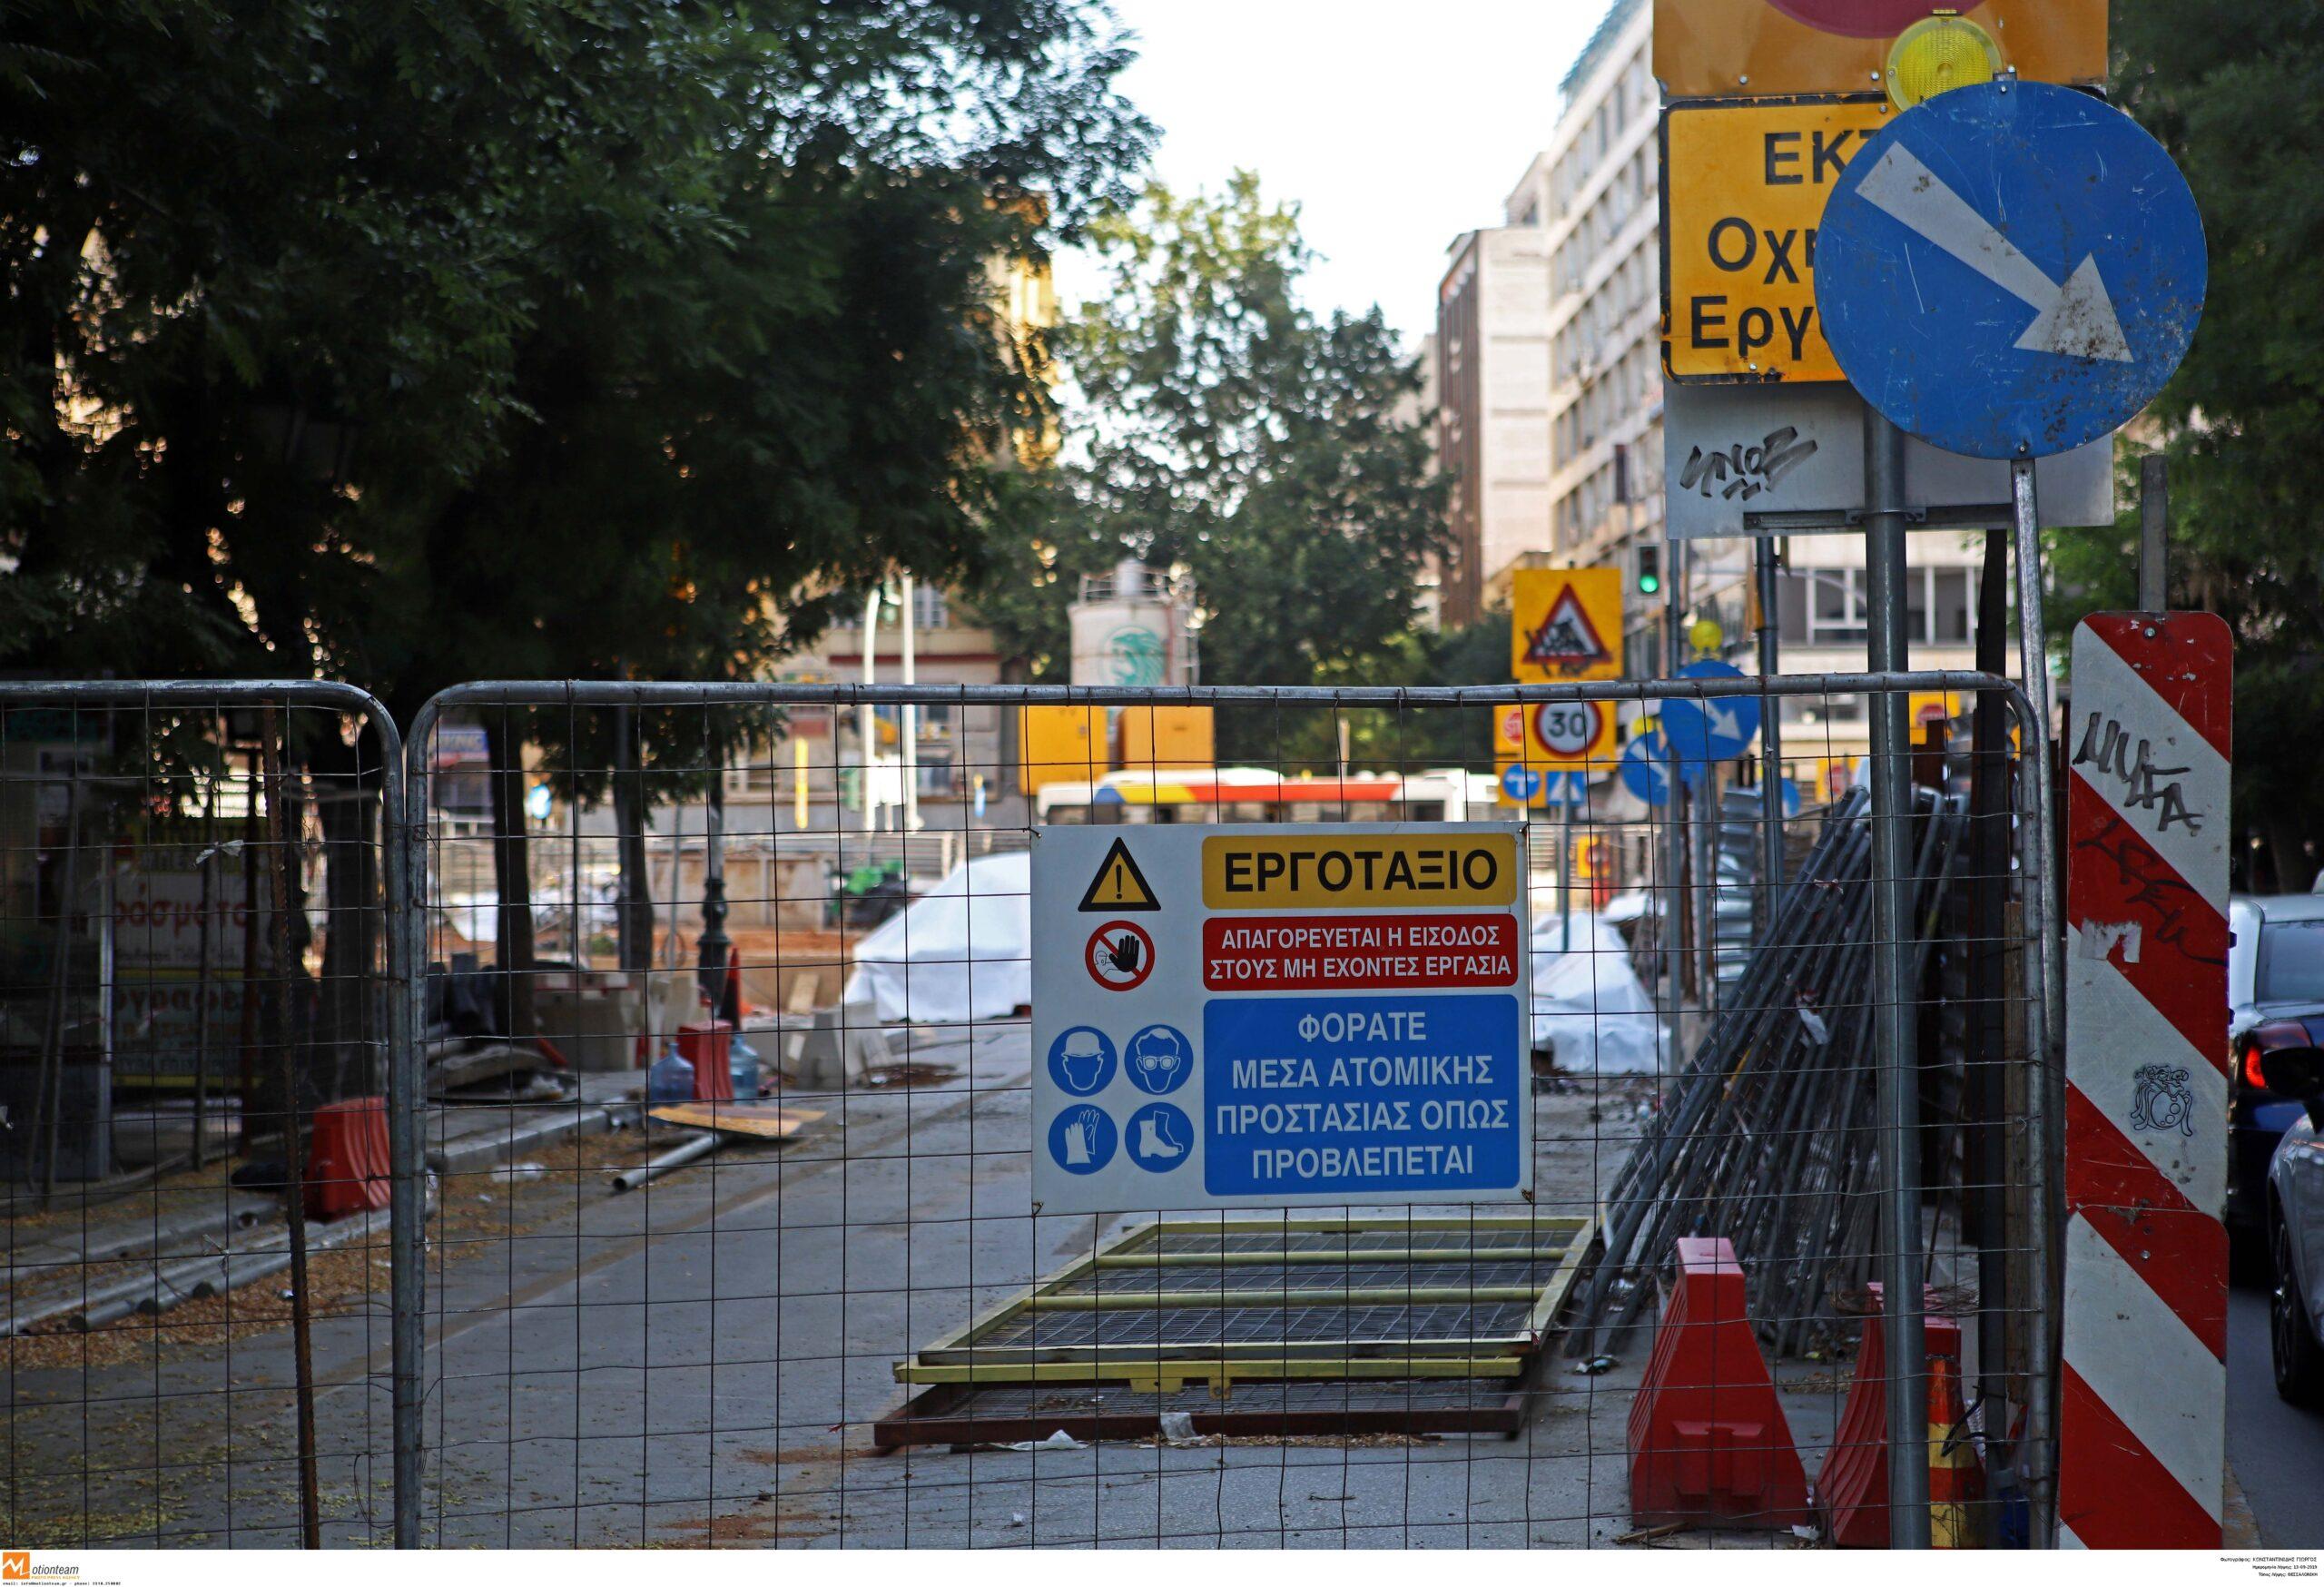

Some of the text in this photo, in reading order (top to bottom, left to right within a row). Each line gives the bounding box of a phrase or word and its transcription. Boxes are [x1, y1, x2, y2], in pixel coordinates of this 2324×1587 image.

[1548, 712, 1586, 738] 30
[1226, 850, 1497, 892] ΕΡΓΟΤΑΞΙΟ
[1222, 926, 1499, 949] ΑΠΑΓΟΡΕΥΕΤΑΙ Η ΕΙΣΟΔΟΣ
[1211, 956, 1511, 979] ΣΤΟΥΣ ΜΗ ΕΧΟΝΤΕΣ ΕΡΓΑΣΙΑ
[1299, 1012, 1426, 1042] ΦΟΡΑΤΕ
[1233, 1056, 1492, 1089] ΜΕΣΑ ΑΤΟΜΙΚΗΣ
[1217, 1099, 1509, 1134] ΠΡΟΣΤΑΣΙΑΣ ΟΠΩΣ
[1254, 1146, 1472, 1178] ΠΡΟΒΛΕΠΕΤΑΙ
